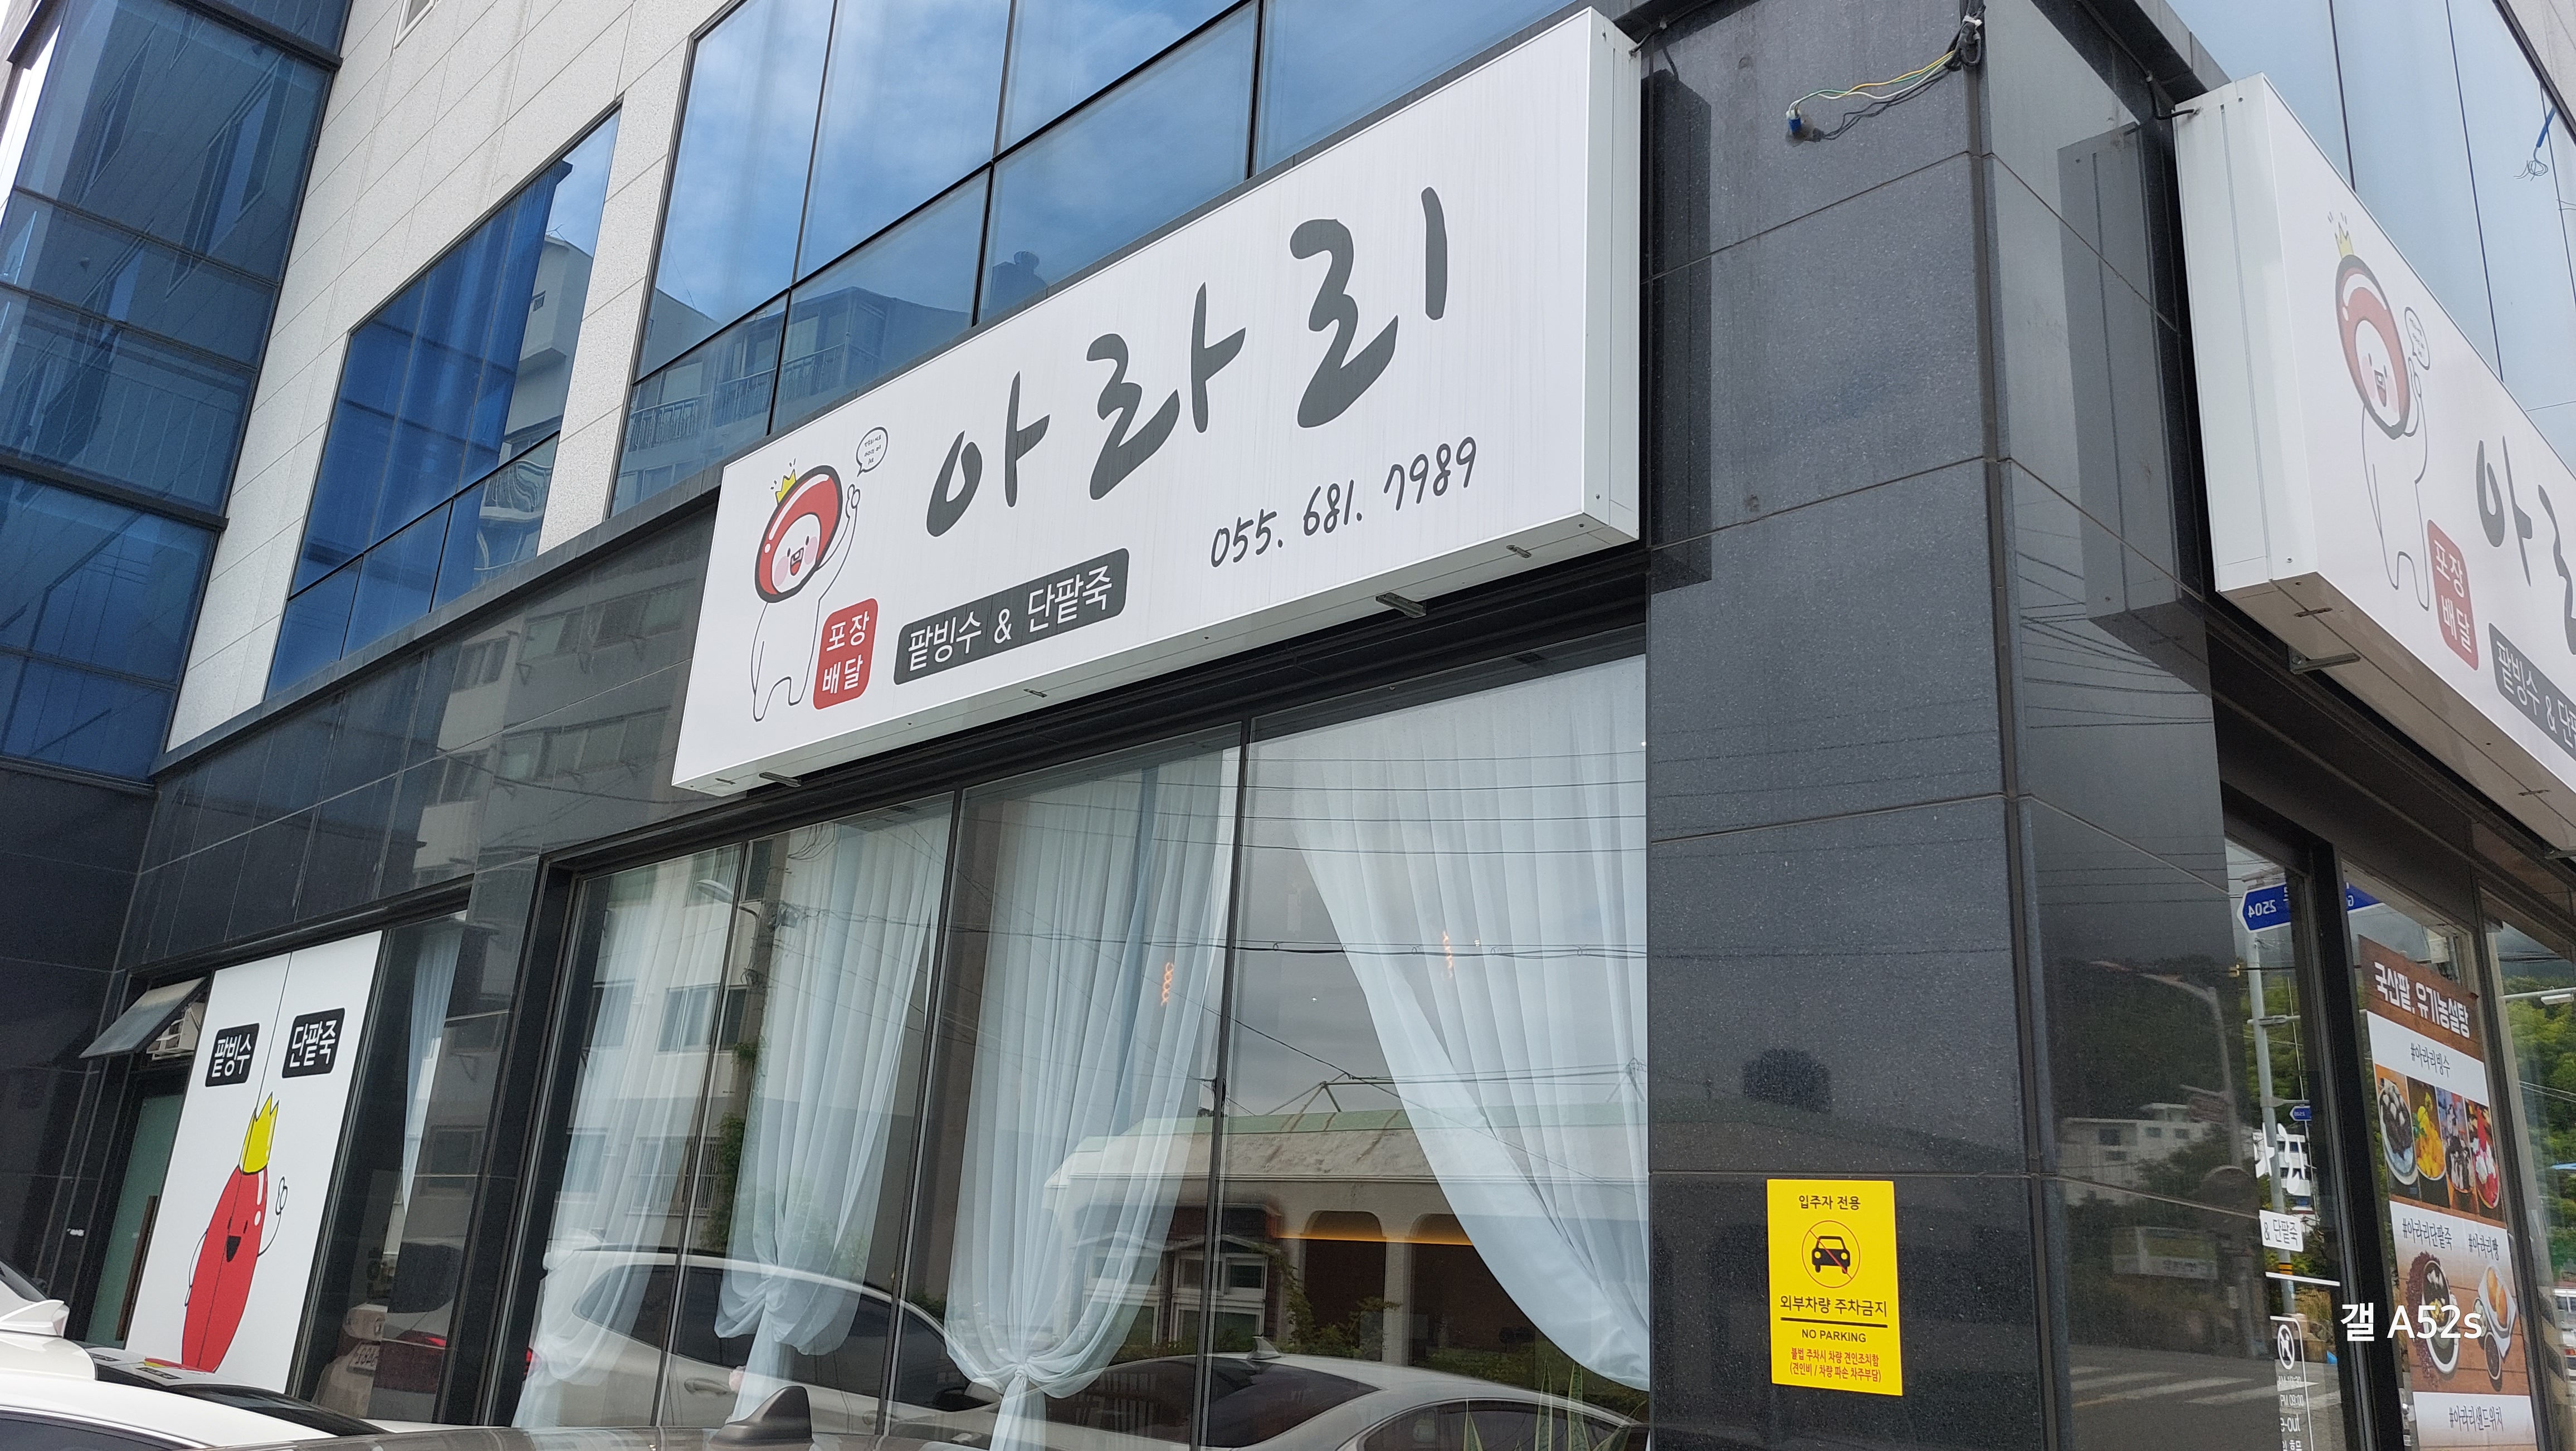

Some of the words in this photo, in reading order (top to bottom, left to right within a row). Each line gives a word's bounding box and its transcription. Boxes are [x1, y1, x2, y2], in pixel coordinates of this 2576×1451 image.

[926, 187, 1447, 537] 아라리
[1211, 509, 1283, 567] 055.
[1302, 482, 1363, 538] 681.
[1383, 436, 1476, 510] 7989
[2434, 540, 2465, 598] 포장
[826, 611, 869, 652] 포장
[908, 611, 981, 671] 팥빙수
[994, 608, 1012, 643] &
[1028, 564, 1112, 632] 단팥죽
[2441, 594, 2472, 654] 배달
[822, 654, 863, 694] 배달
[2496, 640, 2540, 715] 팥빙수
[2545, 695, 2557, 734] &
[2416, 982, 2470, 1039] 유기농설탕
[212, 1034, 251, 1077] 팥빙수
[289, 1020, 337, 1068] 단팥죽
[2409, 1042, 2450, 1078] #아라리빙수
[1799, 1195, 1833, 1210] 입주자
[1837, 1195, 1861, 1210] 전용
[2264, 1222, 2270, 1241] &
[2273, 1219, 2298, 1246] 단팥죽
[2402, 1218, 2452, 1251] #아라리단팥죽
[1780, 1295, 1831, 1314] 외부차량
[1834, 1298, 1887, 1318] 주차금지
[1802, 1328, 1817, 1339] NO
[1819, 1331, 1866, 1343] PARKING
[1790, 1361, 1812, 1376] (견인비
[1819, 1364, 1833, 1378] 차량
[1835, 1366, 1849, 1380] 파손
[1850, 1367, 1881, 1383] 차주부담)
[1791, 1347, 1804, 1360] 불법
[1806, 1348, 1827, 1363] 주차시
[1828, 1350, 1842, 1364] 차량
[1844, 1352, 1879, 1367] 견인조치함
[2448, 1405, 2504, 1432] #아라리샌드위치
